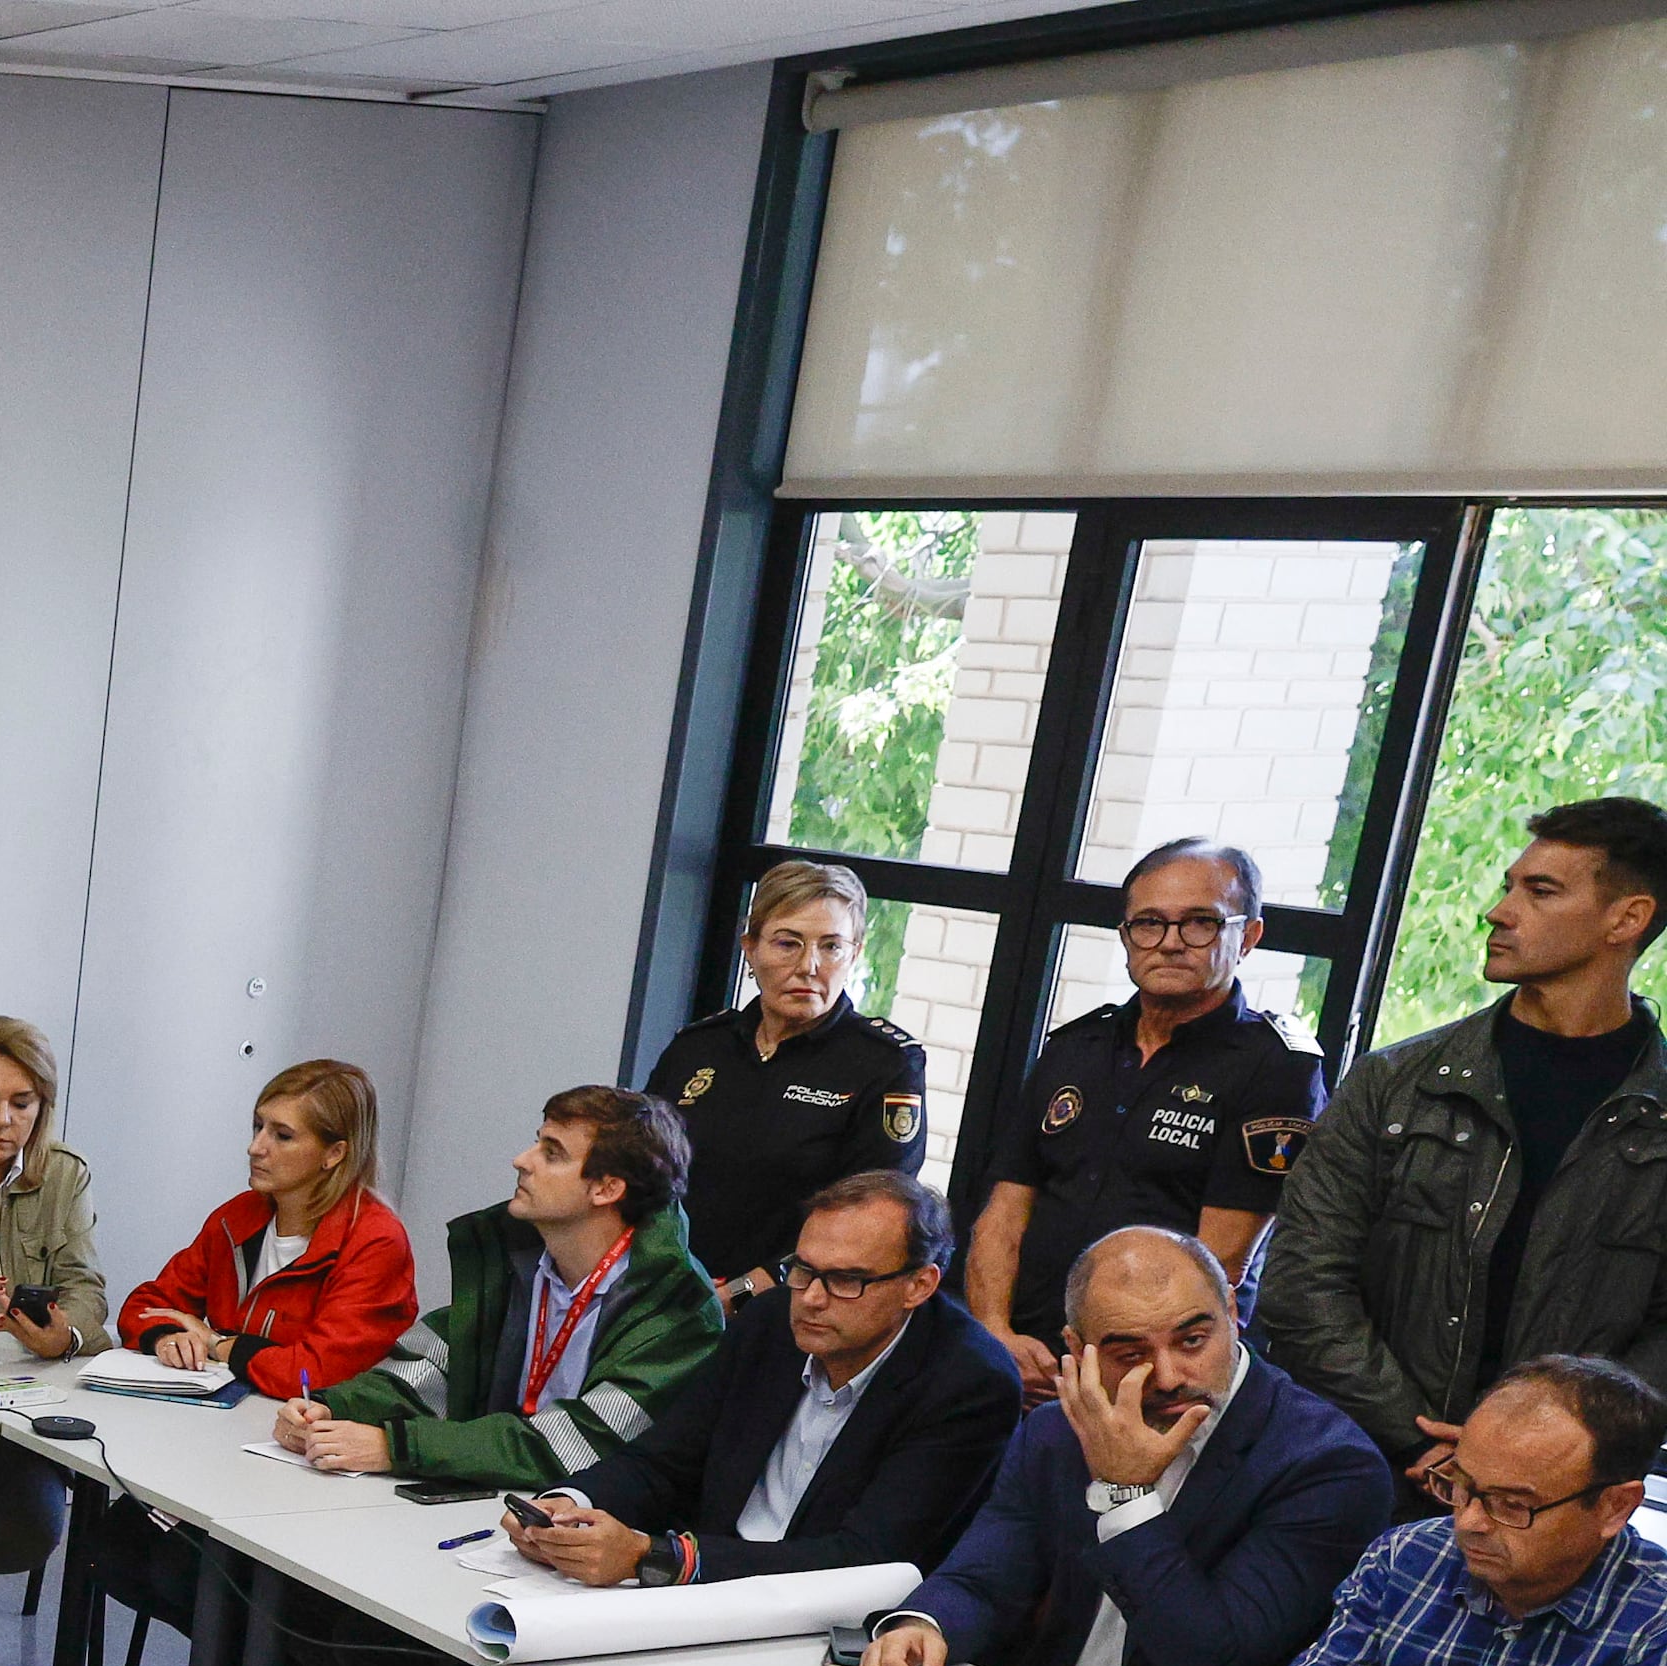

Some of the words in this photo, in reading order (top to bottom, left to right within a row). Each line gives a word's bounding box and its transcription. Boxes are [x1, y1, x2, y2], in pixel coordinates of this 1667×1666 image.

[787, 1085, 840, 1100] POLICIA
[1152, 1109, 1216, 1134] POLICIA
[1148, 1125, 1201, 1150] LOCAL
